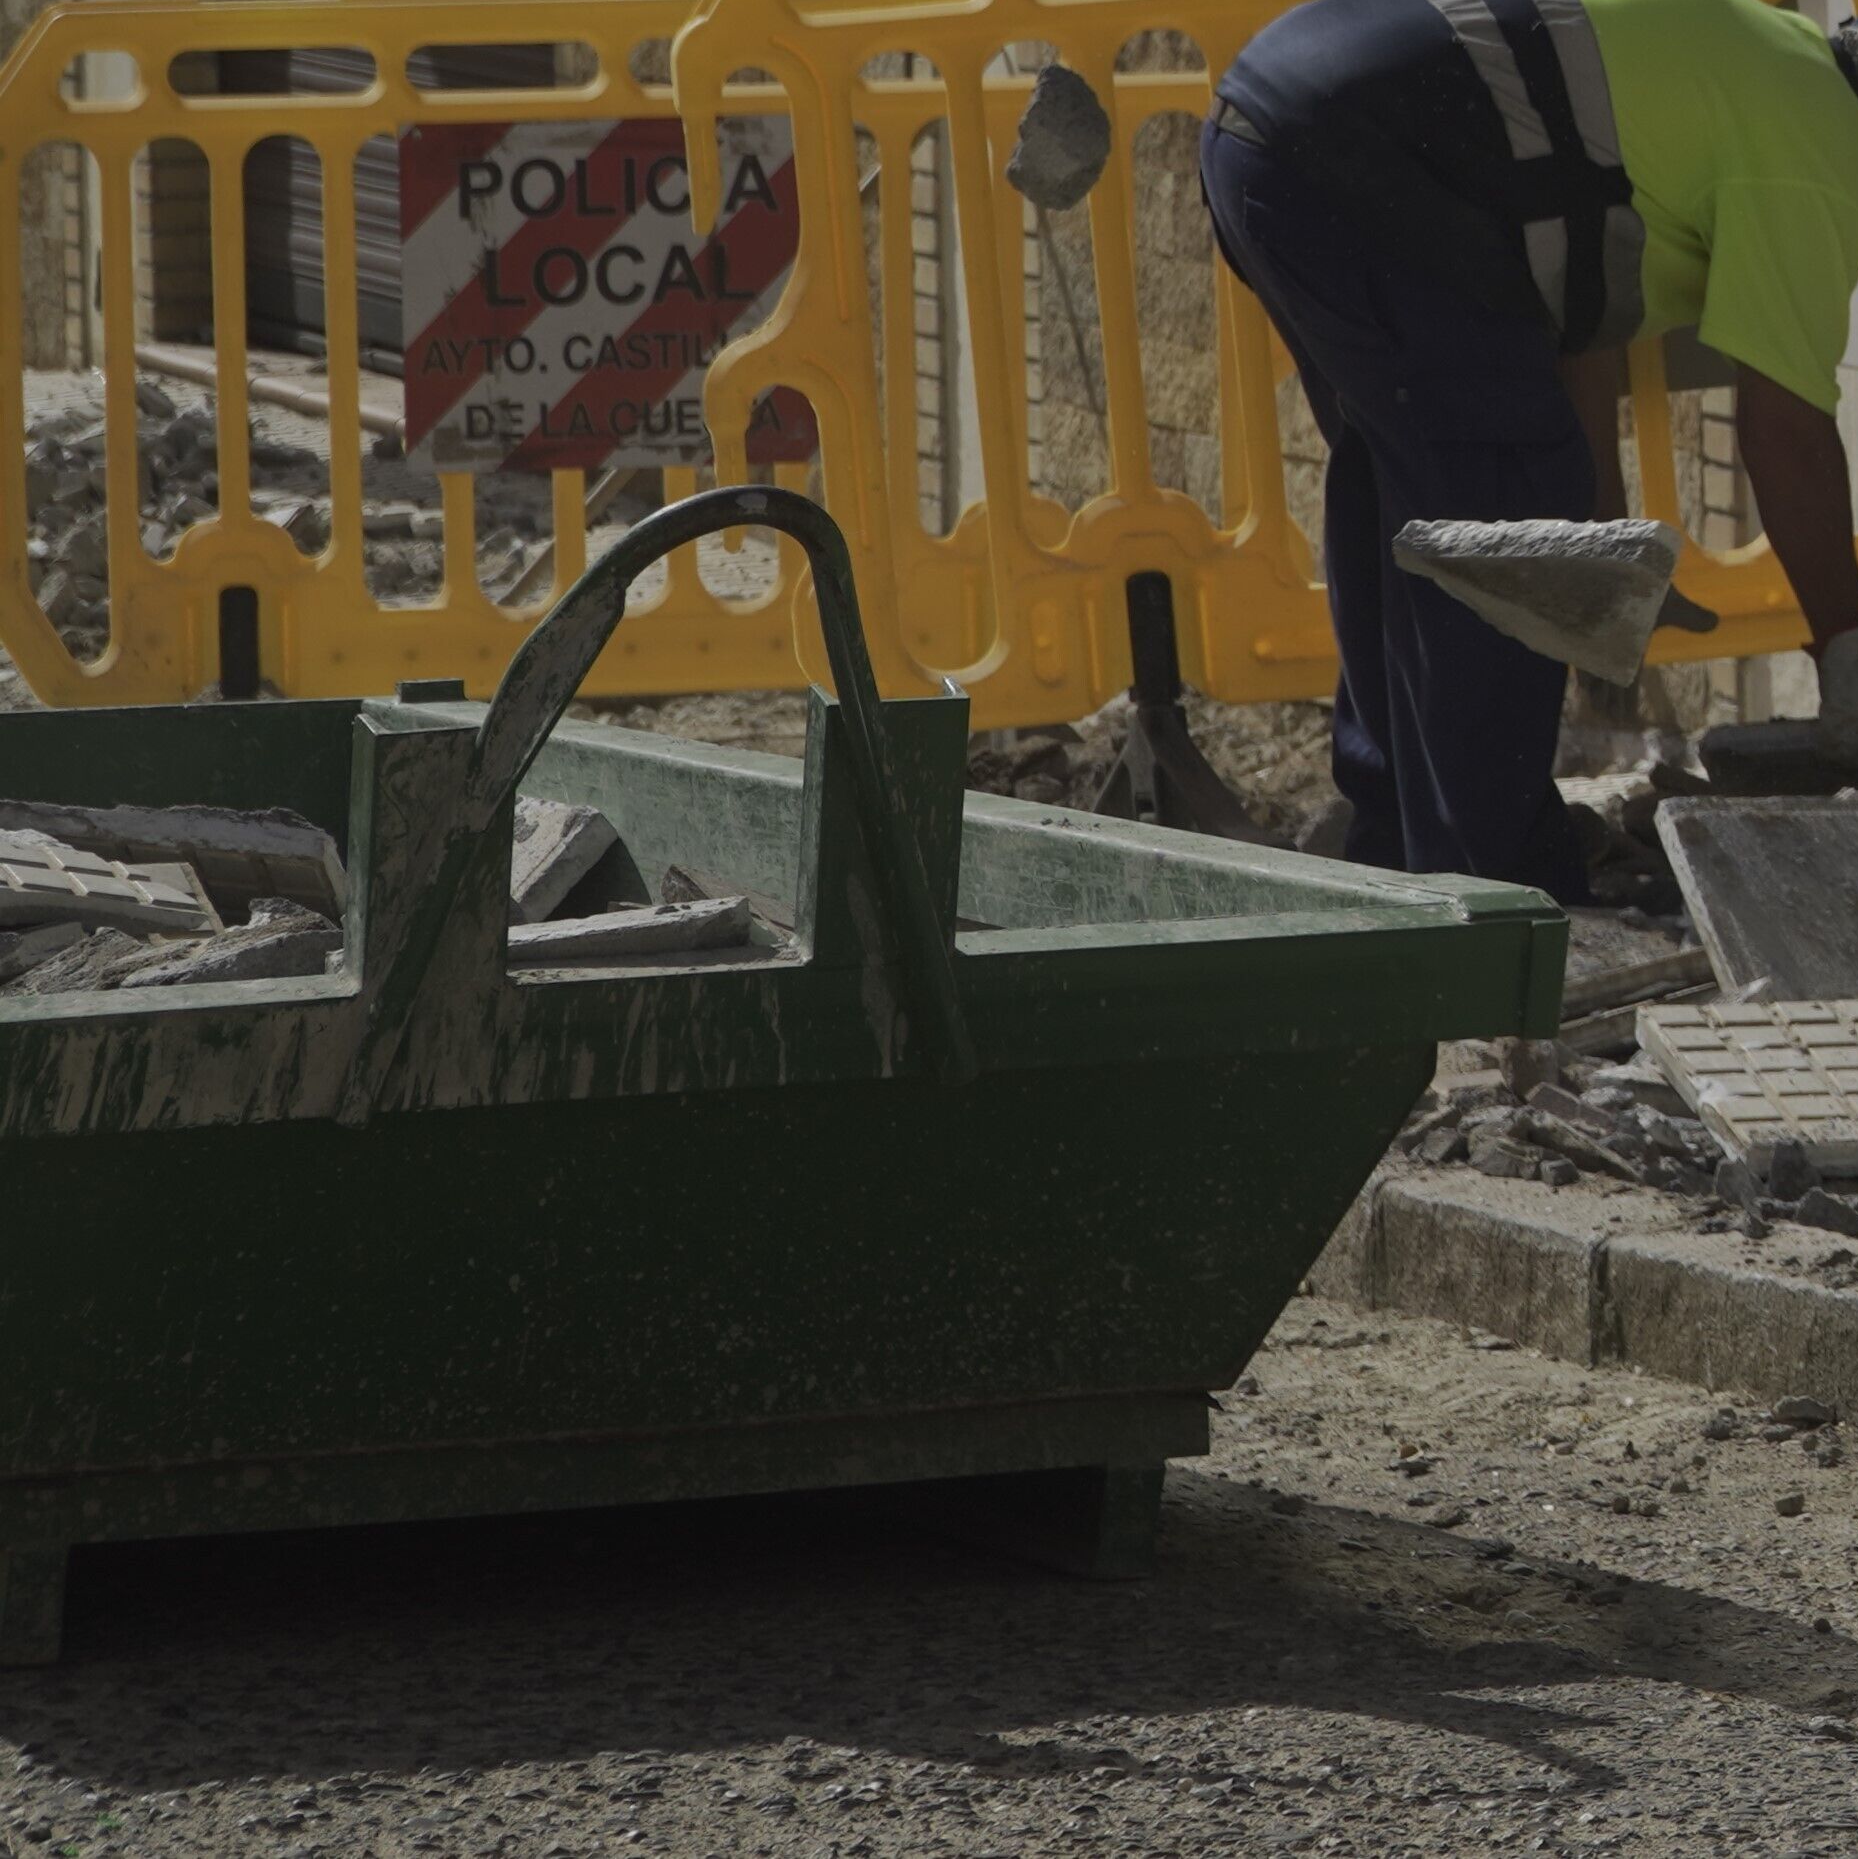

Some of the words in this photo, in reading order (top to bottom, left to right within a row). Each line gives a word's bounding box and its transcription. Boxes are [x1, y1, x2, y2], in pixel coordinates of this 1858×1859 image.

[457, 153, 779, 220] POLICA
[483, 244, 756, 309] LOCAL
[421, 334, 549, 376] AYTO.
[465, 400, 526, 444] DE
[539, 398, 596, 439] LA
[608, 396, 782, 437] CUEA
